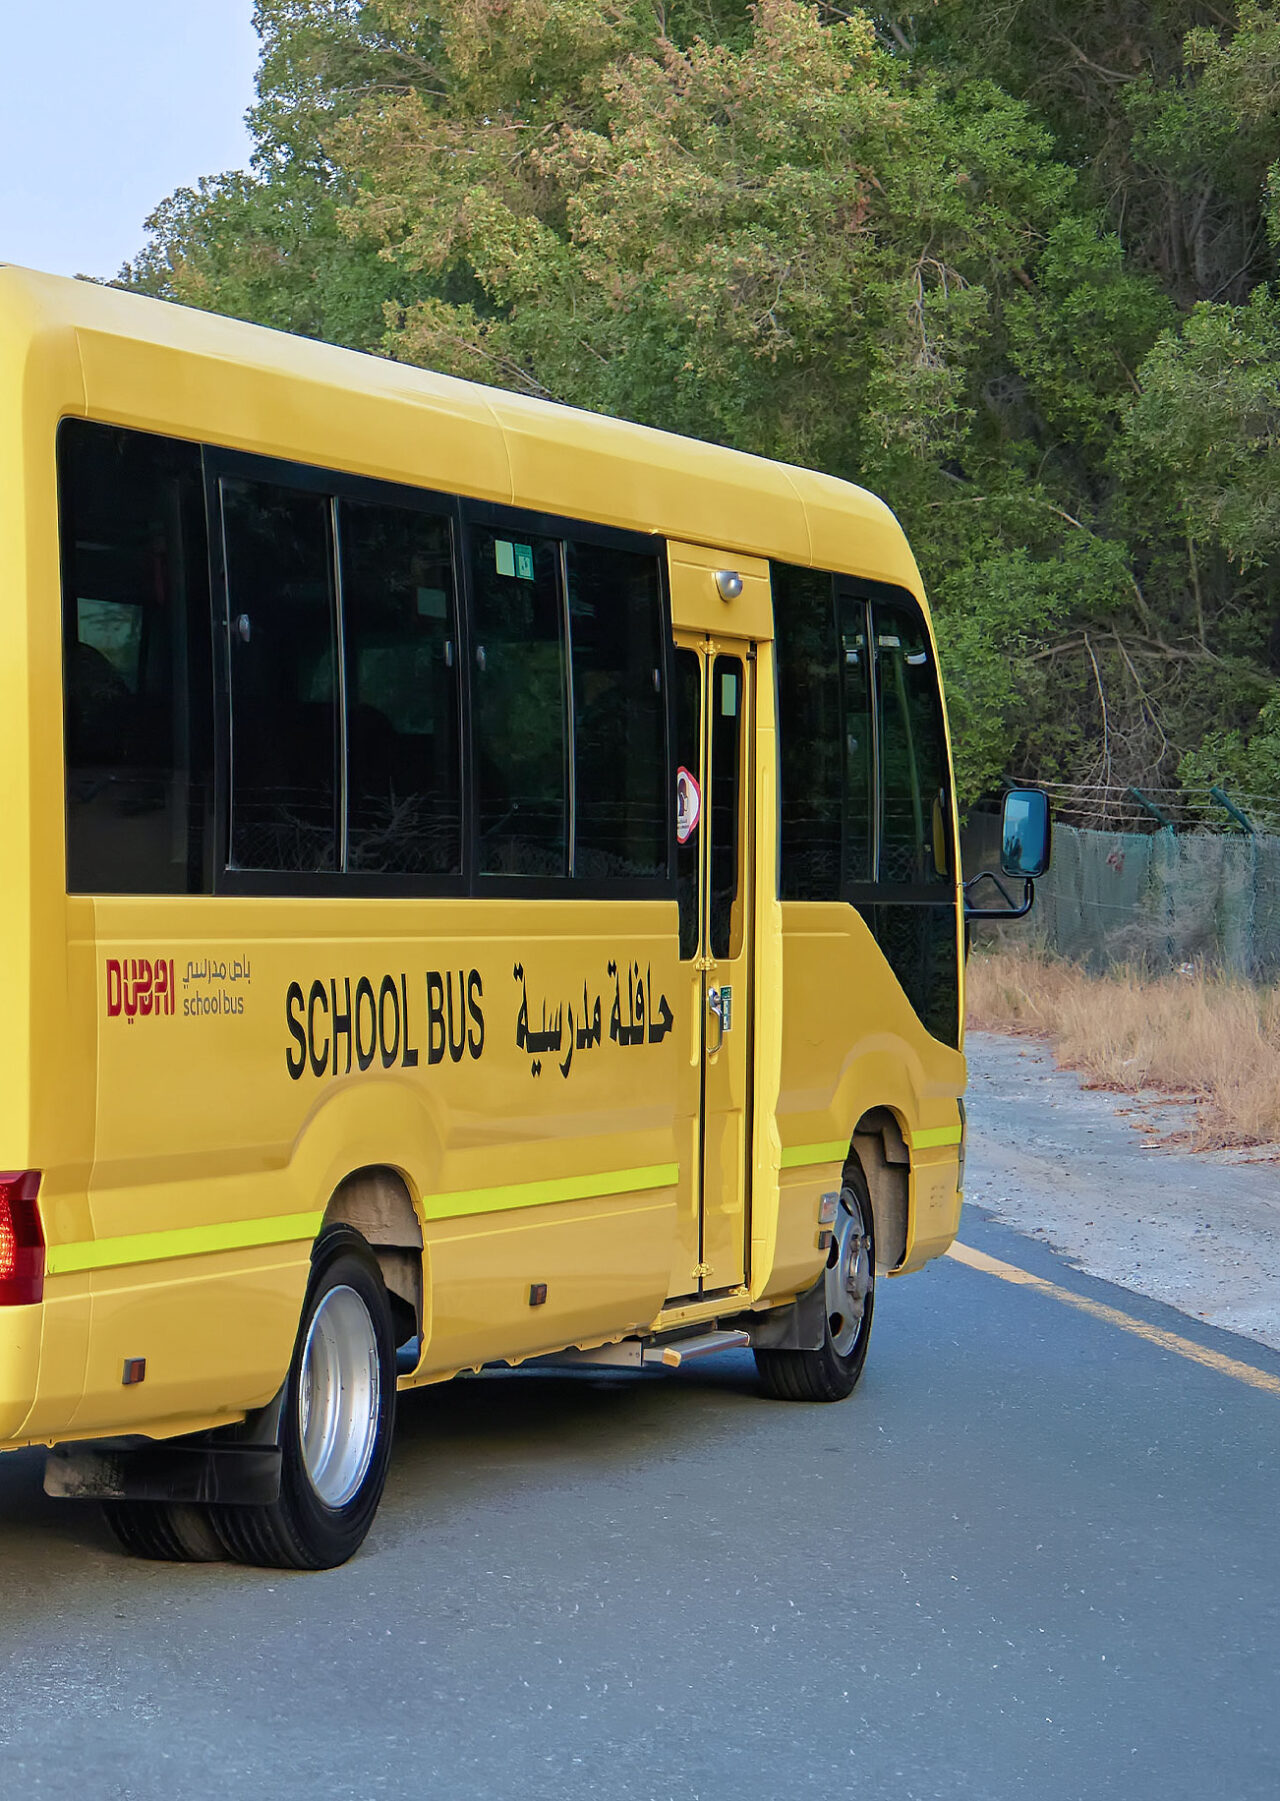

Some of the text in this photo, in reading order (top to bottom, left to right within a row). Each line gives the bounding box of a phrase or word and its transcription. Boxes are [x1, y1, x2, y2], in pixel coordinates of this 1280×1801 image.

[106, 958, 175, 1019] DUBAI
[182, 953, 251, 990] باص مدرسي
[183, 989, 244, 1017] school bus
[286, 969, 485, 1081] SCHOOL BUS
[607, 959, 674, 1047] حافلة
